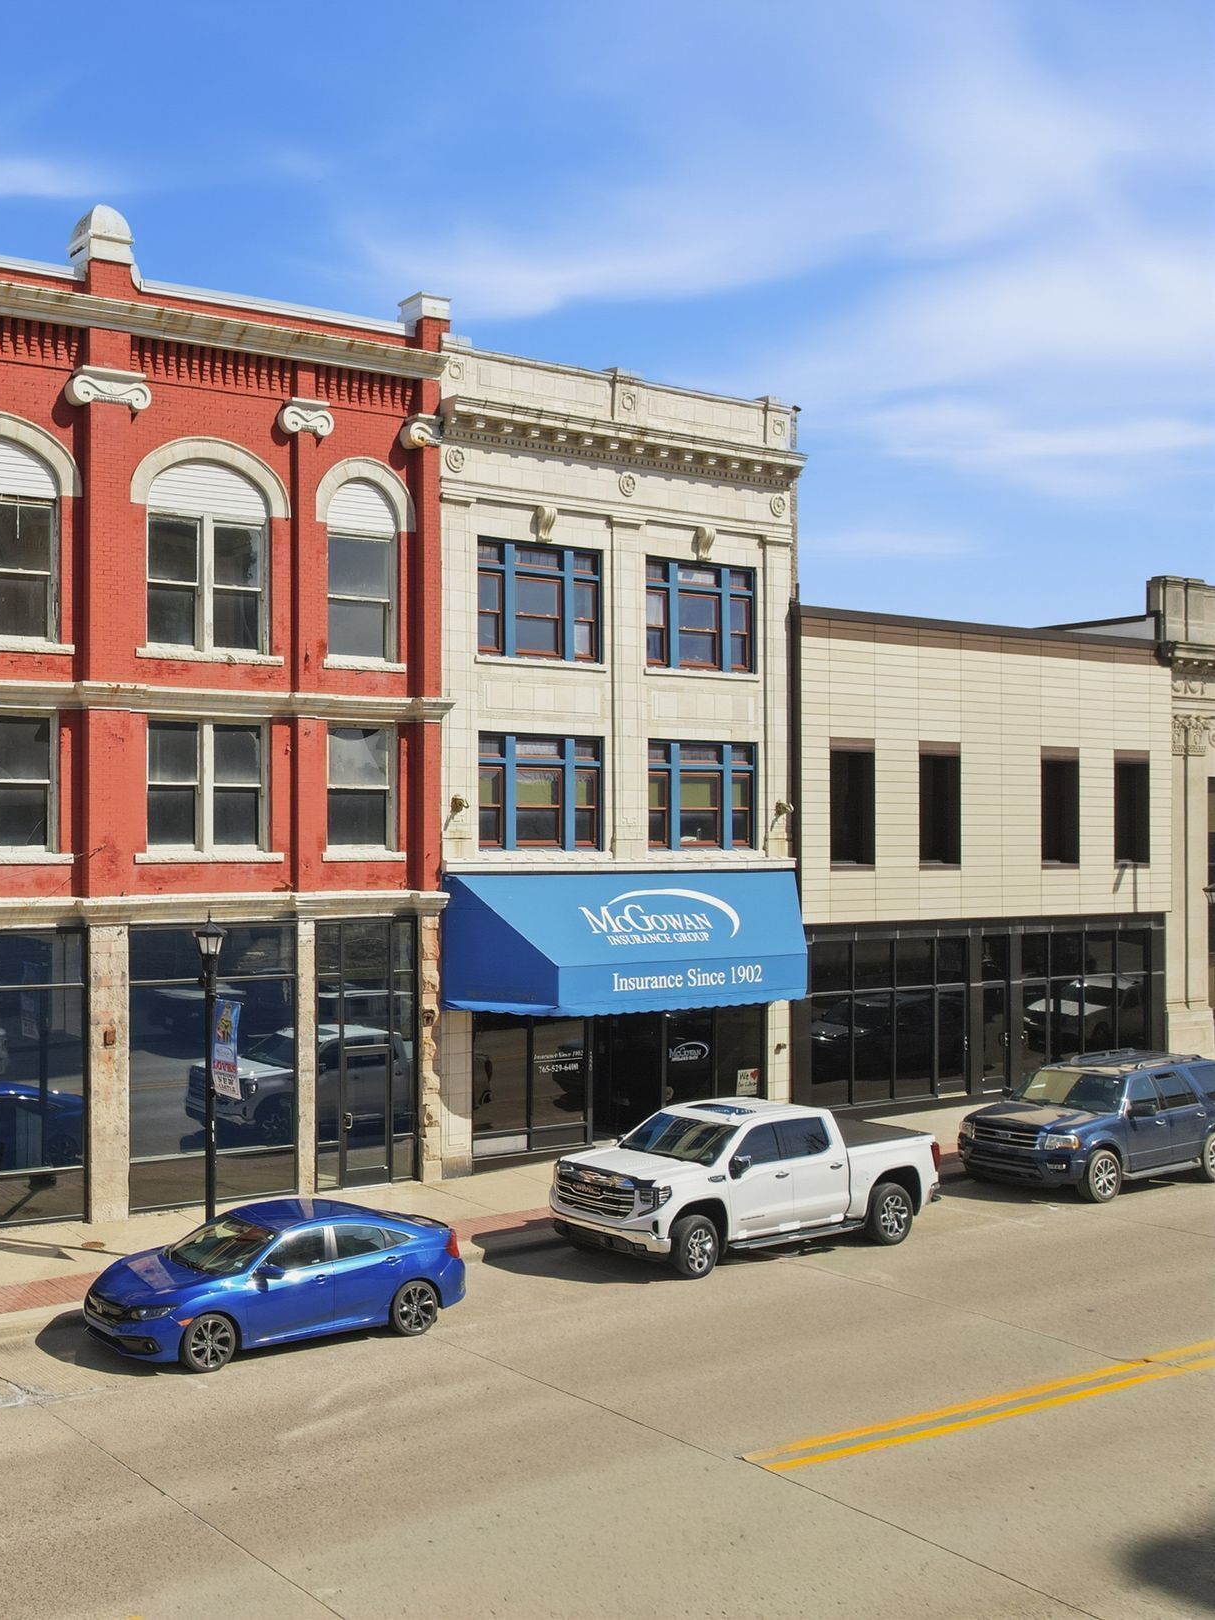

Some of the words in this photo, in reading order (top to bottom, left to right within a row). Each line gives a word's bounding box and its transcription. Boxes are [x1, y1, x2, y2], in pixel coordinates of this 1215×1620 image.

[606, 933, 674, 946] INSURANCE
[673, 931, 710, 944] GROUP
[612, 972, 684, 992] Insurance
[687, 968, 726, 987] Since
[730, 964, 763, 984] 1902
[213, 1060, 237, 1073] LOVES
[217, 1075, 235, 1086] NEW
[738, 1071, 749, 1080] We
